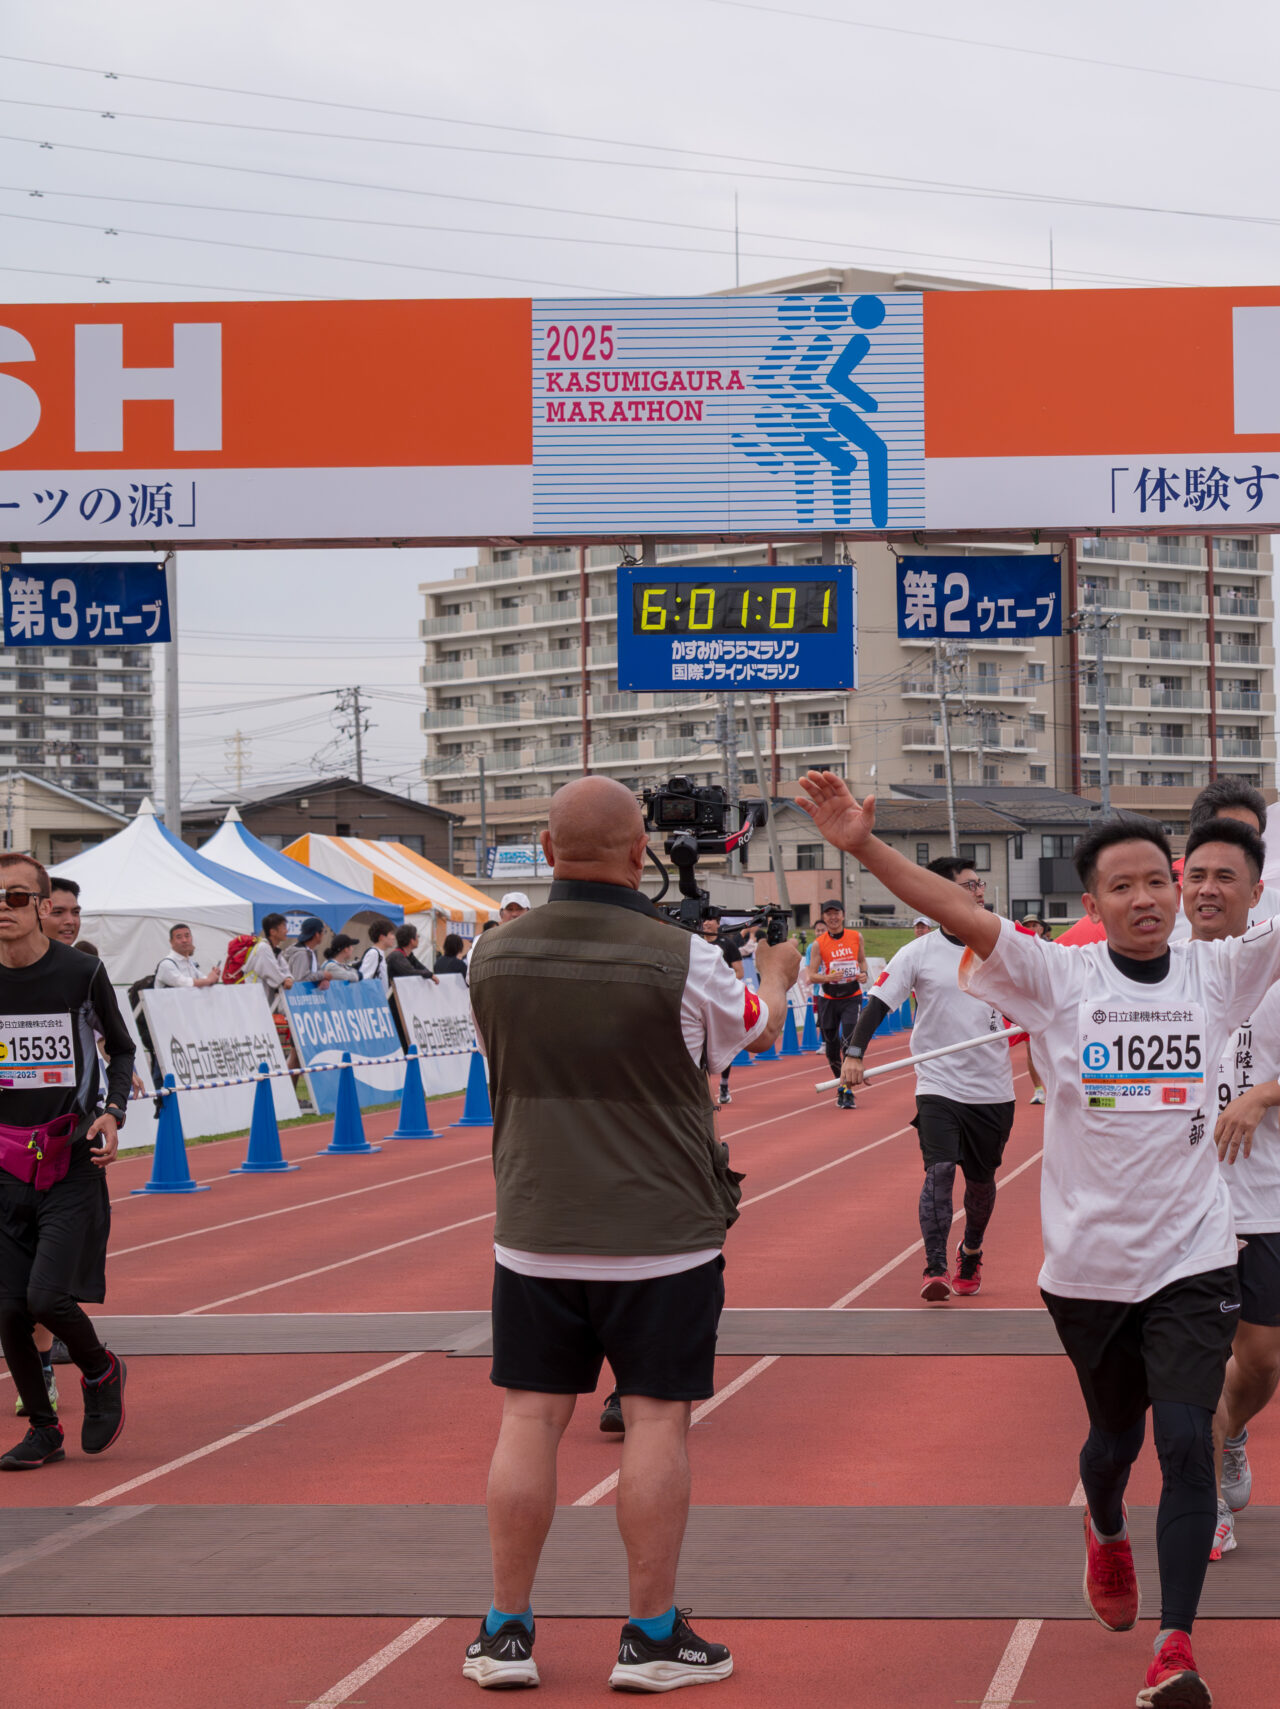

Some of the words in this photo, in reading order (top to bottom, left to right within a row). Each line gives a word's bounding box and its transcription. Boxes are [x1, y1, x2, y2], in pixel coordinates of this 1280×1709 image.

[546, 325, 614, 361] 2025
[546, 370, 745, 393] KASUMIGAURA
[546, 400, 703, 423] MARATHON
[641, 588, 831, 631] 6:01:01
[671, 639, 799, 660] かすみがうらマラソン
[672, 661, 799, 681] 国際ブラインドマラソン
[831, 947, 853, 958] LIXIL
[4, 1019, 64, 1029] 日立建機株式会社
[293, 1009, 351, 1047] POCARI
[346, 1006, 395, 1043] SWEAT
[1109, 1010, 1194, 1022] 日立建機株式会社
[9, 1035, 71, 1061] 15533
[1089, 1046, 1106, 1067] B
[1112, 1034, 1201, 1071] 16255
[17, 1071, 37, 1079] 2025
[1121, 1085, 1151, 1097] 2025
[678, 1647, 708, 1664] HOKA
